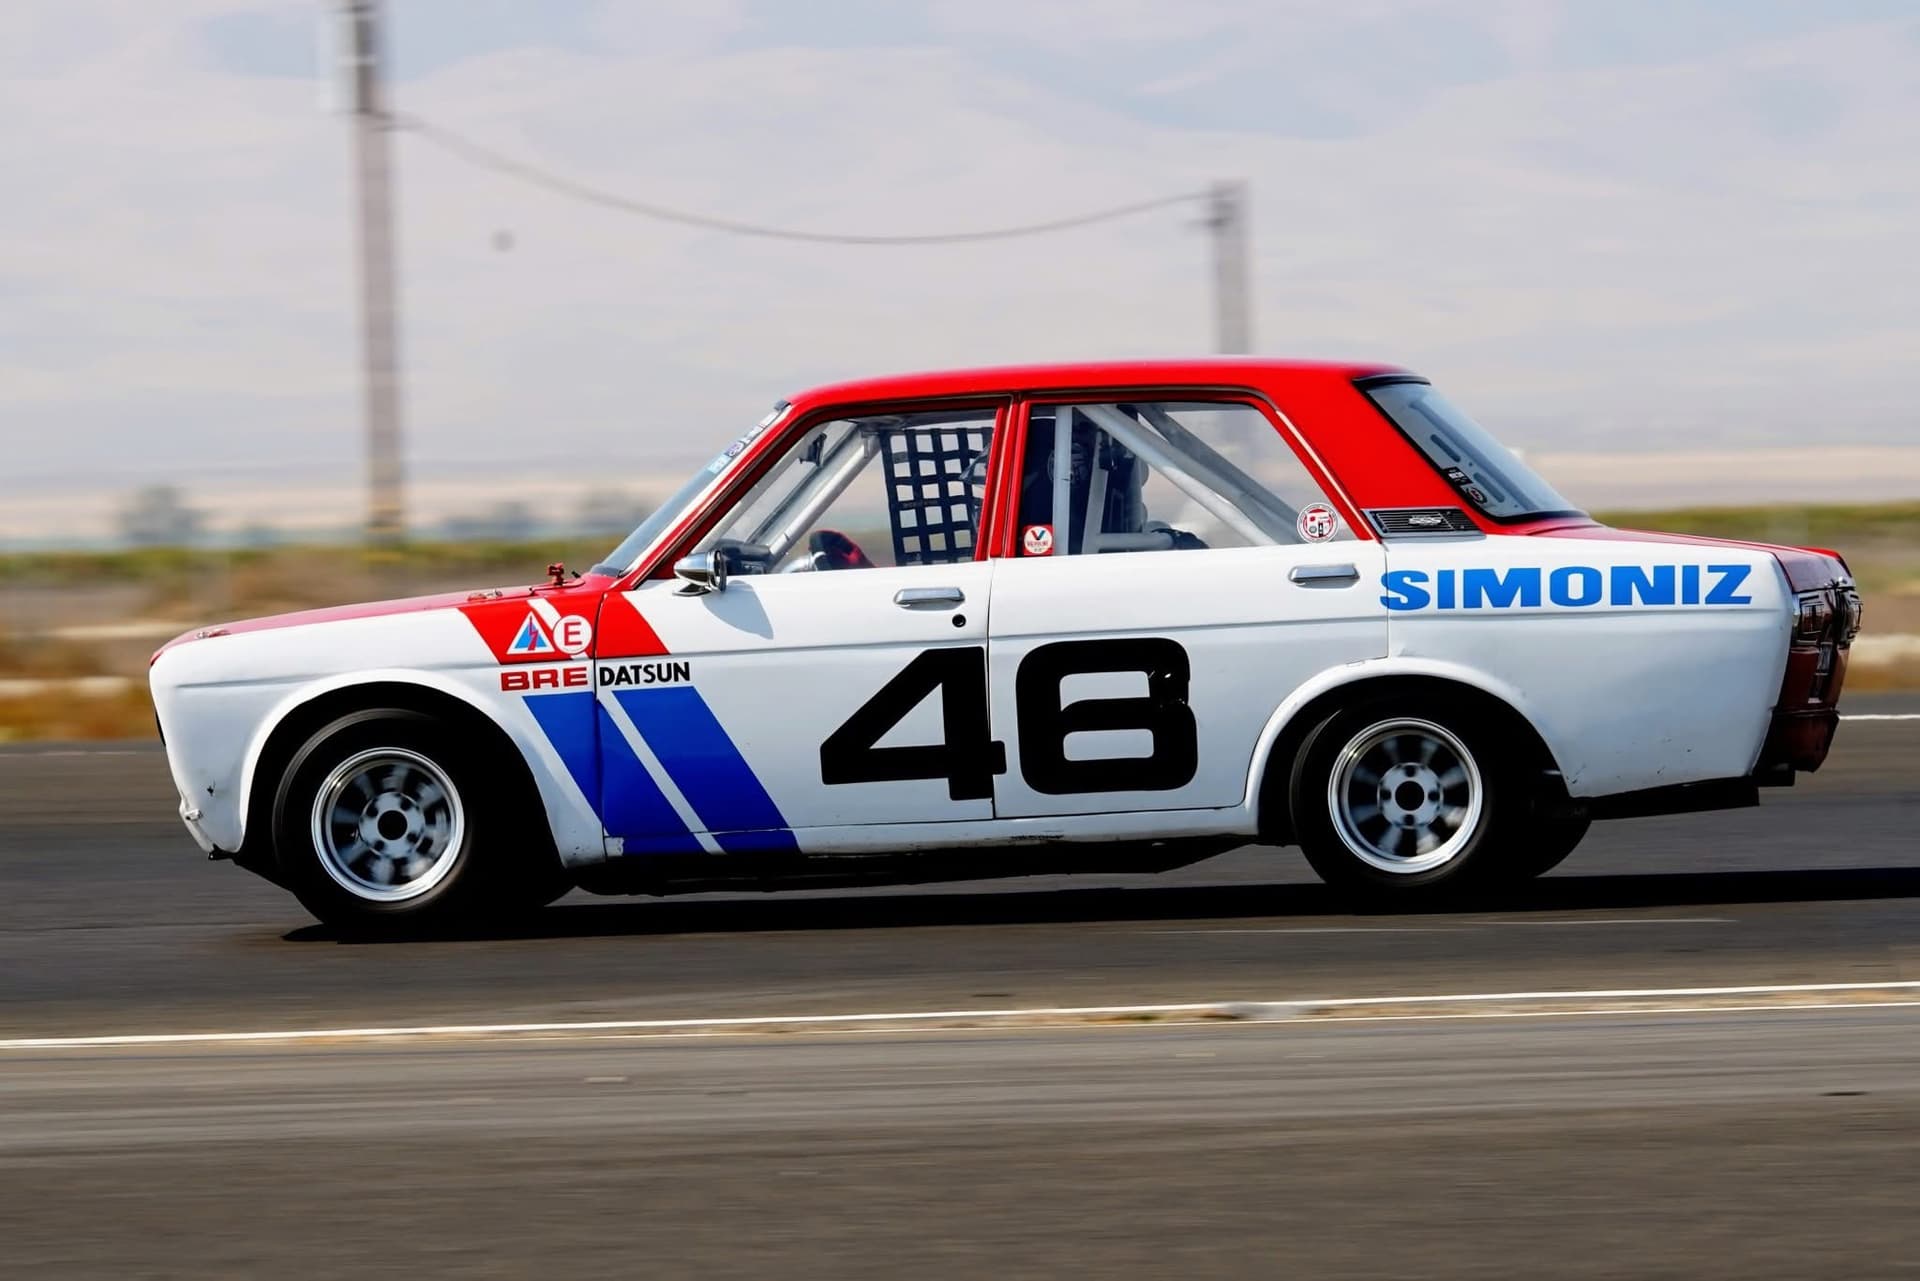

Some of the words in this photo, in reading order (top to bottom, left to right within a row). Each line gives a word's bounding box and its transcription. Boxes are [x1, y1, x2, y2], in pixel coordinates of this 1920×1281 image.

[1380, 564, 1752, 612] SIMONIZ
[563, 621, 583, 647] E
[500, 666, 588, 691] BRE
[599, 661, 690, 687] DATSUN
